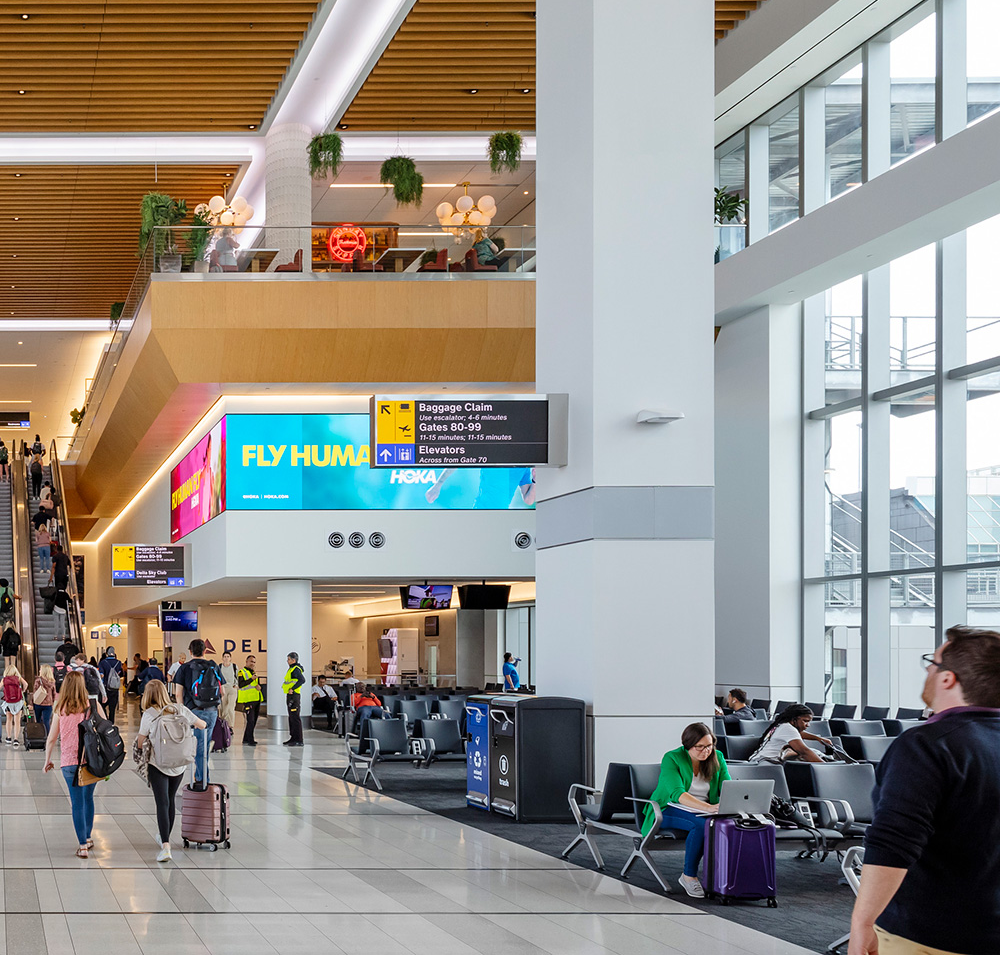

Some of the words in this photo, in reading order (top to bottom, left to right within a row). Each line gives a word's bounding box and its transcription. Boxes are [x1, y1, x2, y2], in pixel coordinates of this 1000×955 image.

[419, 403, 462, 413] Baggage
[464, 403, 492, 411] Claim
[419, 423, 448, 431] Gates
[450, 423, 481, 431] 80-99
[419, 446, 465, 454] Elevators
[242, 445, 287, 466] FLY
[291, 445, 370, 466] HUMA
[390, 470, 436, 484] HOKA
[168, 602, 176, 610] 71
[224, 639, 267, 652] DEL
